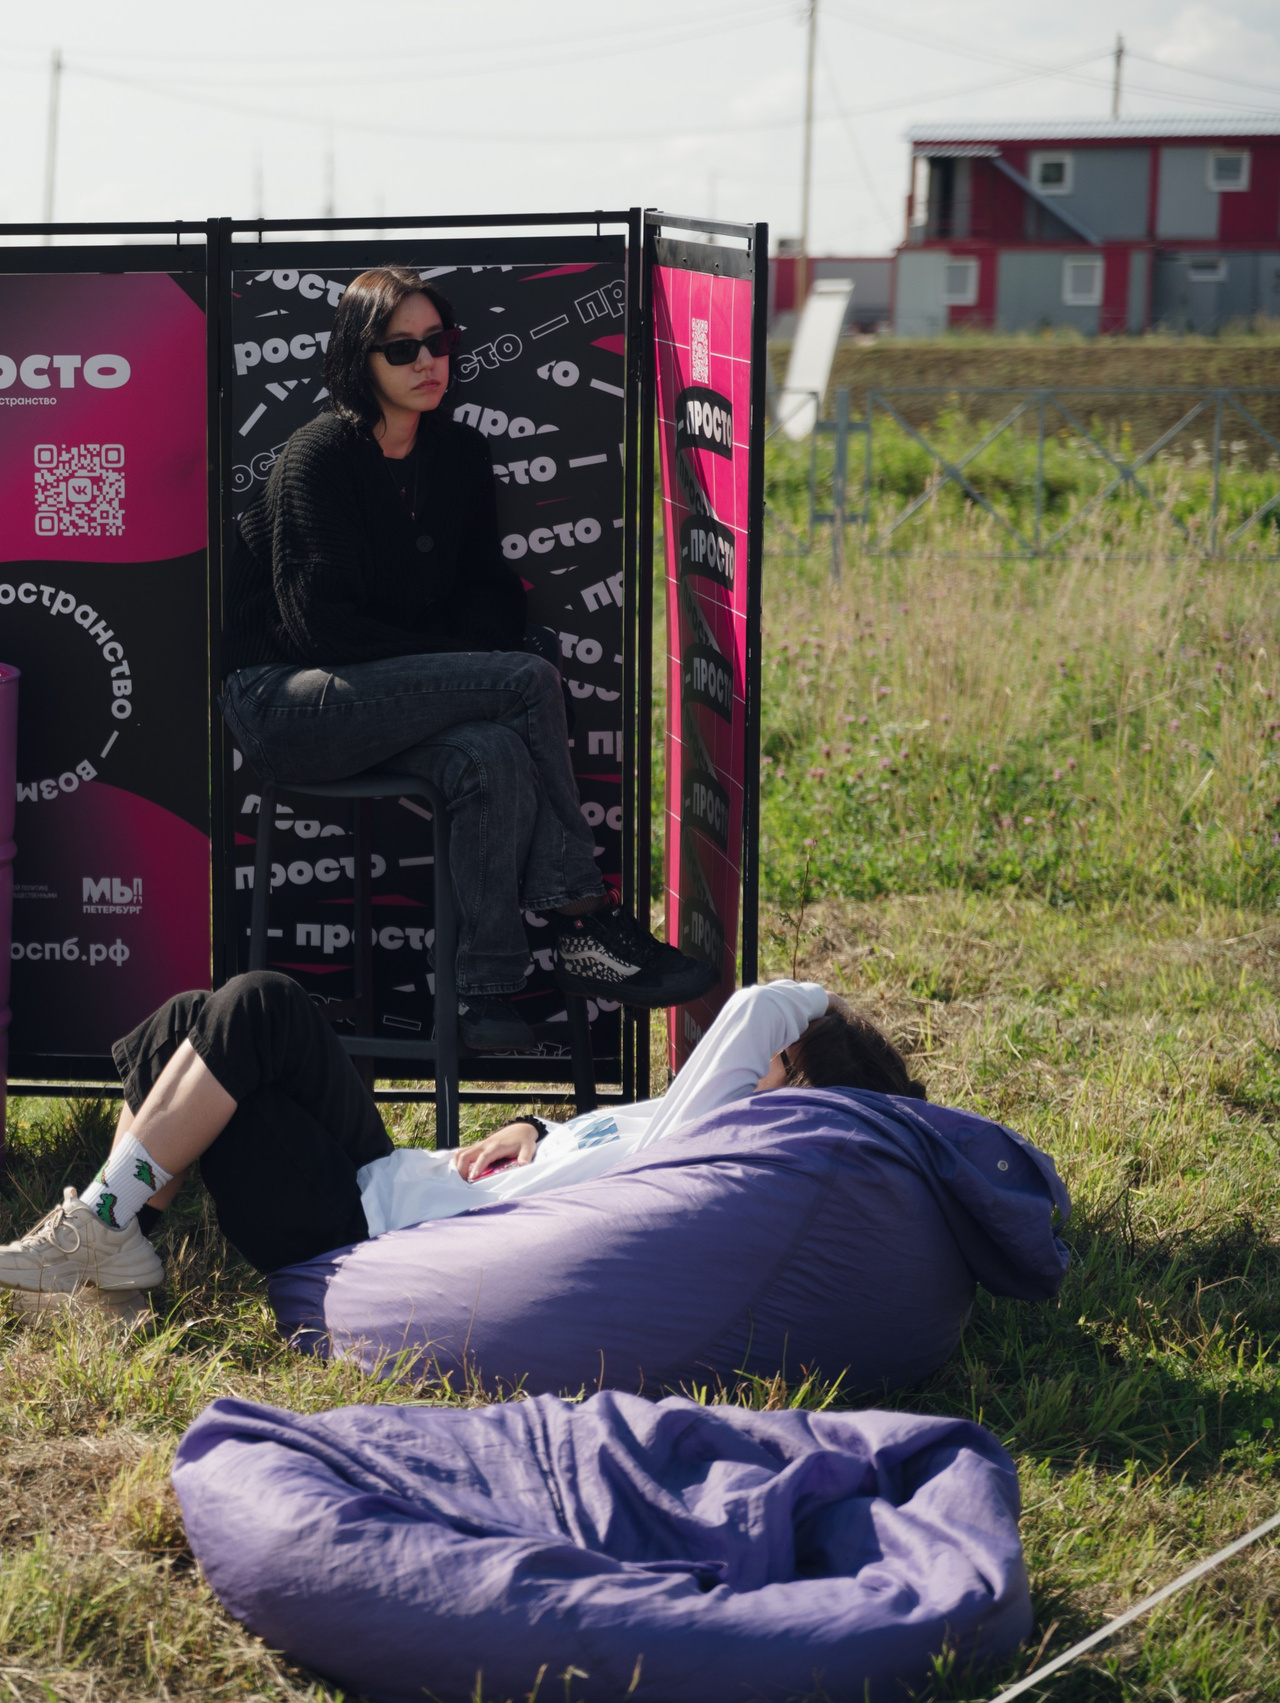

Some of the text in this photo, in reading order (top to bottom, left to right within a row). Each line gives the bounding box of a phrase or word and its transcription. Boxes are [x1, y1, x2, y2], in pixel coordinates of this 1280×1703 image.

[686, 400, 732, 449] ПРОСТО
[501, 518, 601, 559] осто
[690, 528, 734, 581] ПРОСТО
[83, 905, 143, 914] ПЕТЕРБУРГ
[10, 937, 130, 967] оспб.рф
